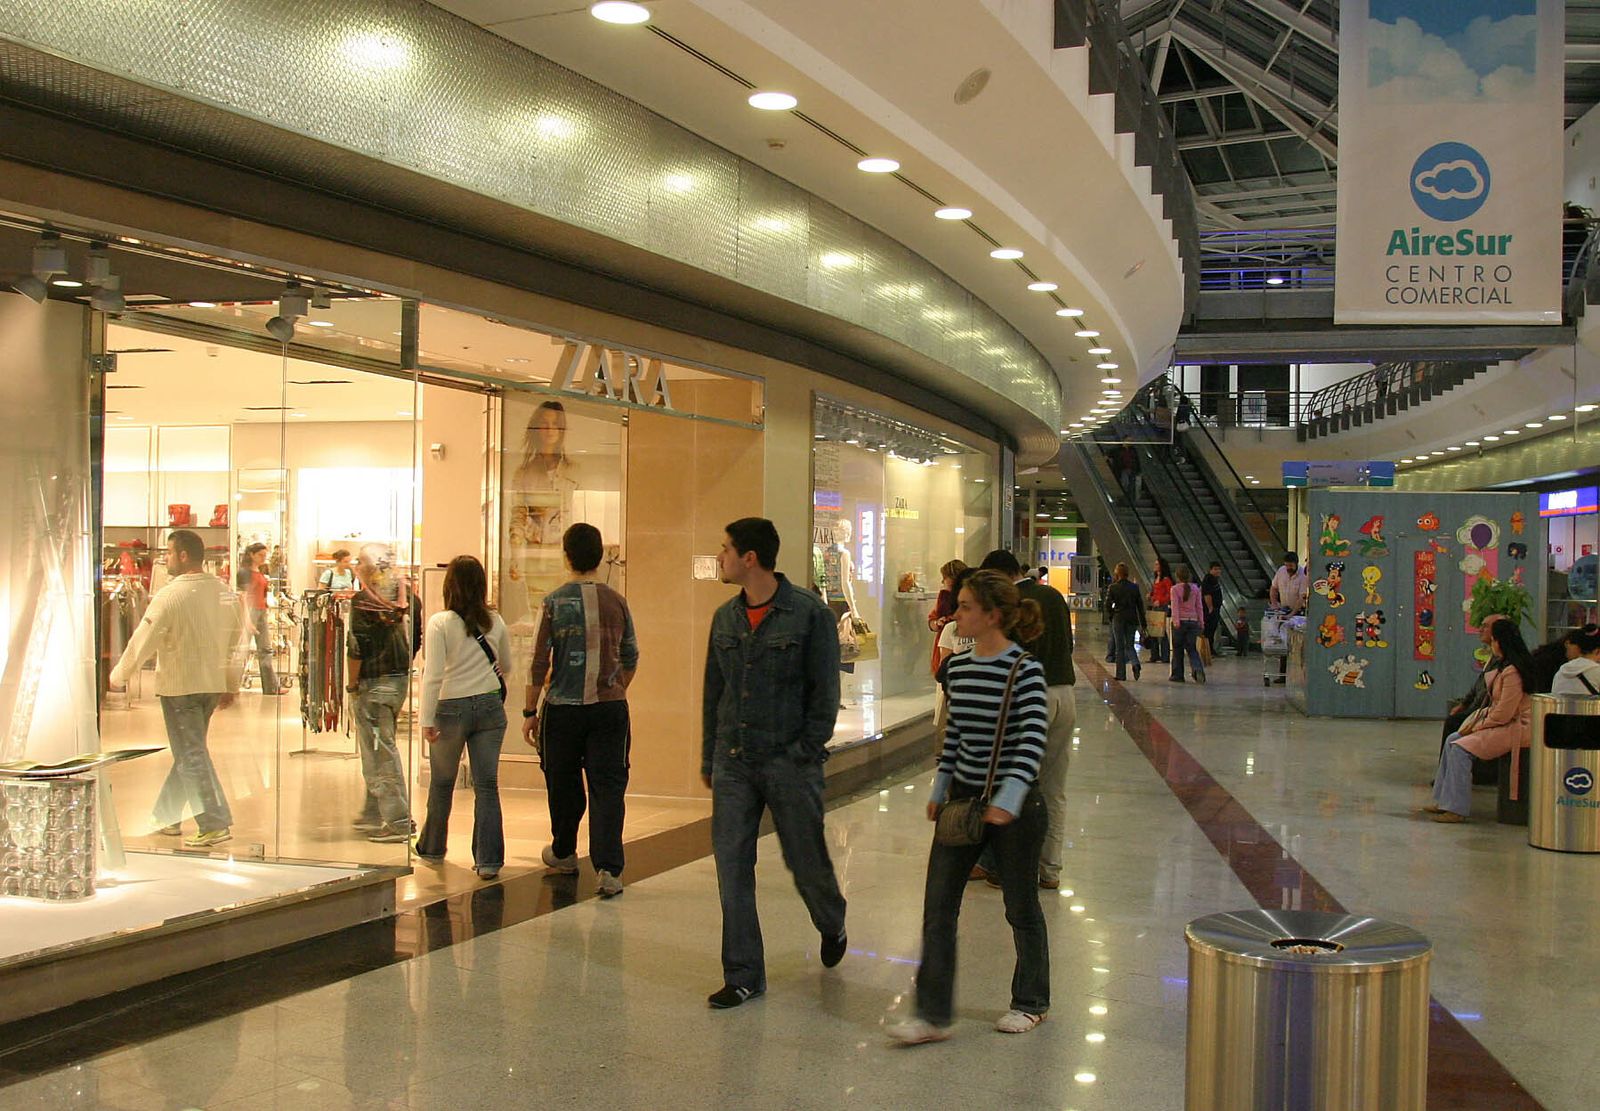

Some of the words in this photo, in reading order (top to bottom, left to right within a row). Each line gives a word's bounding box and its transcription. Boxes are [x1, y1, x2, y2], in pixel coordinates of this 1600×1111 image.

[1387, 227, 1512, 256] AireSur
[1386, 265, 1512, 283] CENTRO
[1385, 287, 1513, 304] COMERCIAL
[557, 338, 675, 410] ZARA
[814, 527, 834, 543] ZARA
